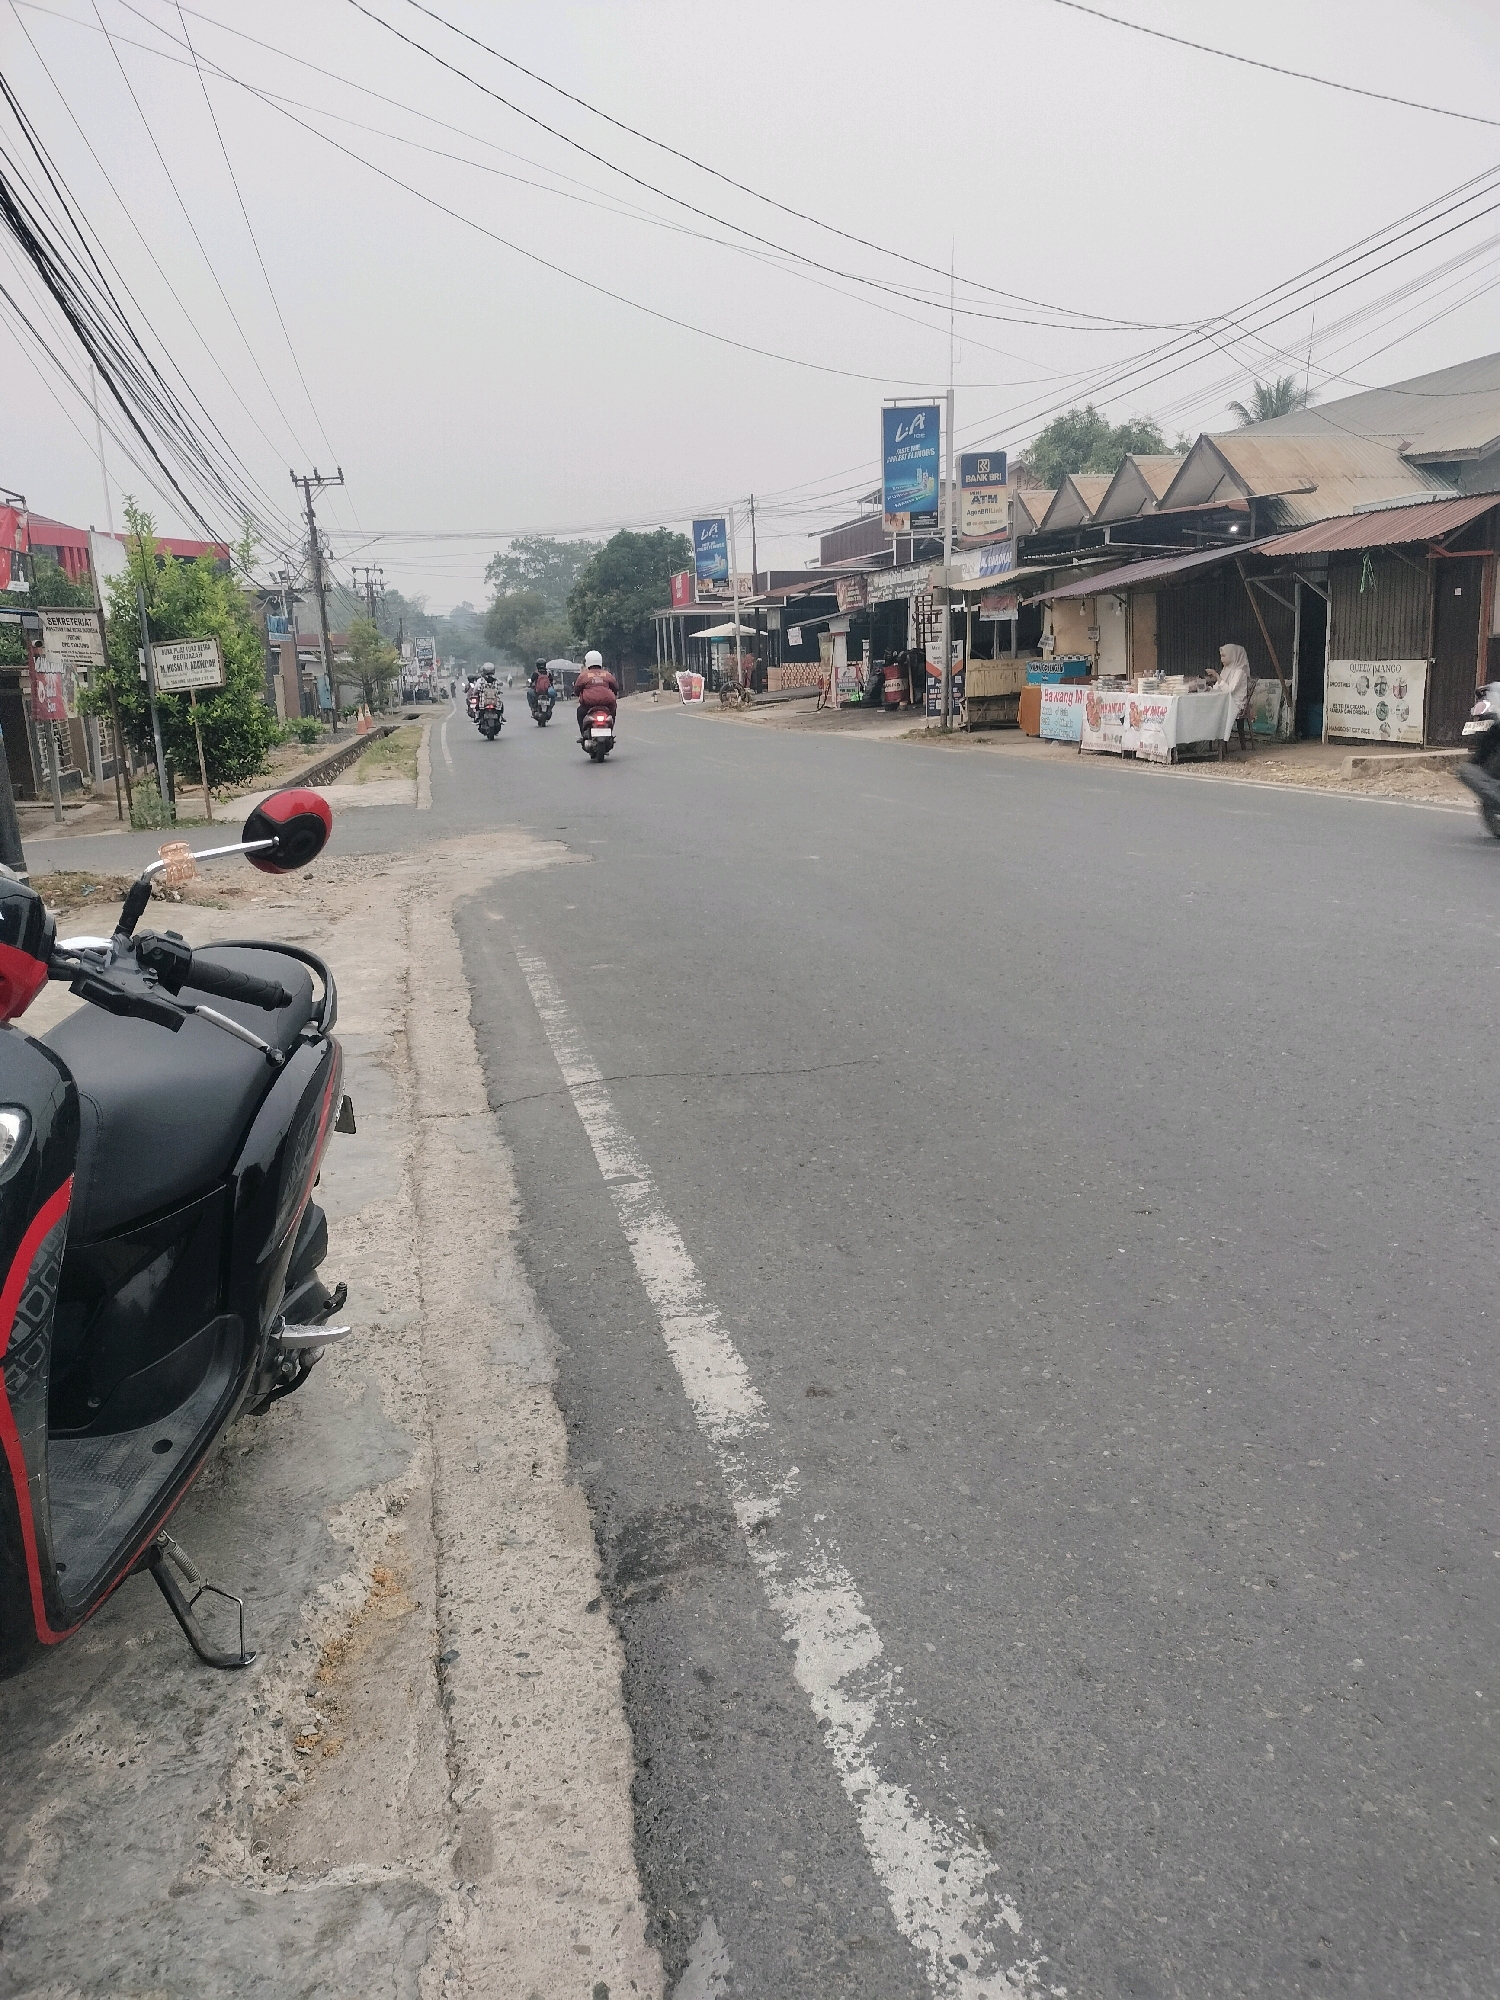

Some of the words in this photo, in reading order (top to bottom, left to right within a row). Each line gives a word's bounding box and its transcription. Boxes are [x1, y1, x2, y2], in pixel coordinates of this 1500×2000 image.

[965, 473, 988, 483] BANK
[989, 472, 1002, 481] BRI
[970, 494, 998, 504] ATM
[1349, 662, 1372, 674] QUEEN
[1374, 664, 1402, 673] MANGO
[1044, 688, 1074, 707] Bawang
